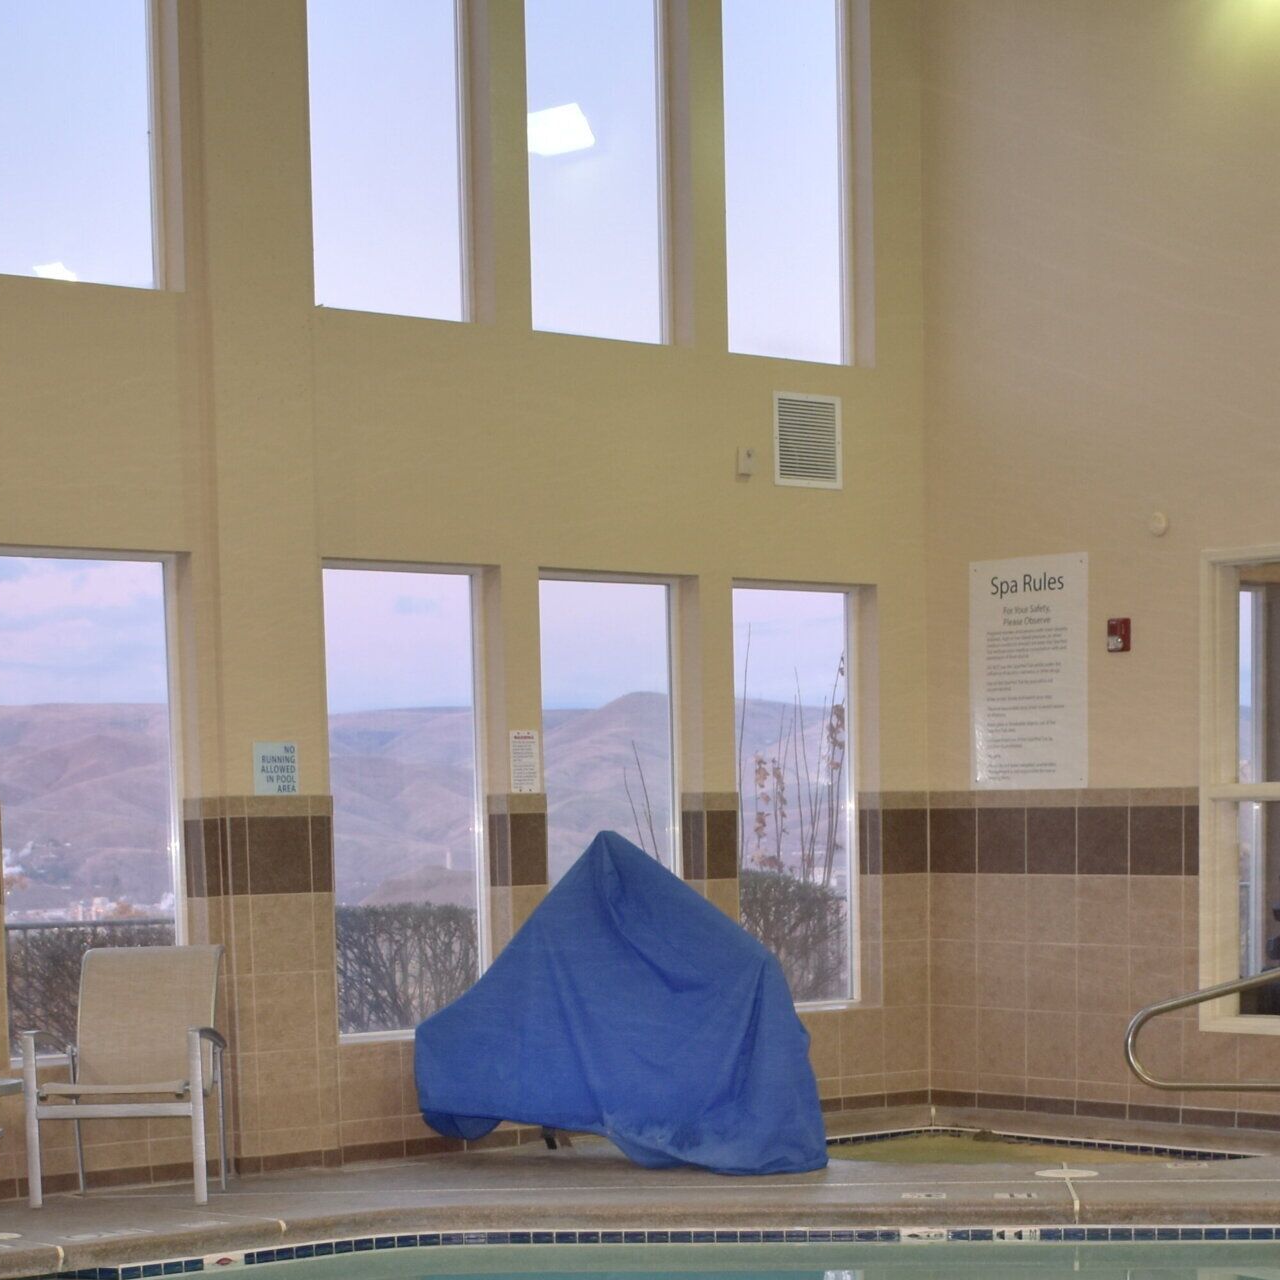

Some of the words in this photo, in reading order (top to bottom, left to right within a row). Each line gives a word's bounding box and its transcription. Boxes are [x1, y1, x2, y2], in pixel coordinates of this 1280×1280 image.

[990, 576, 1018, 599] Spa
[1023, 571, 1064, 593] Rules
[284, 745, 296, 754] NO
[261, 755, 296, 764] RUNNING
[261, 764, 296, 774] ALLOWED
[266, 774, 274, 783] IN
[276, 774, 297, 783] POOL
[277, 784, 297, 793] AREA
